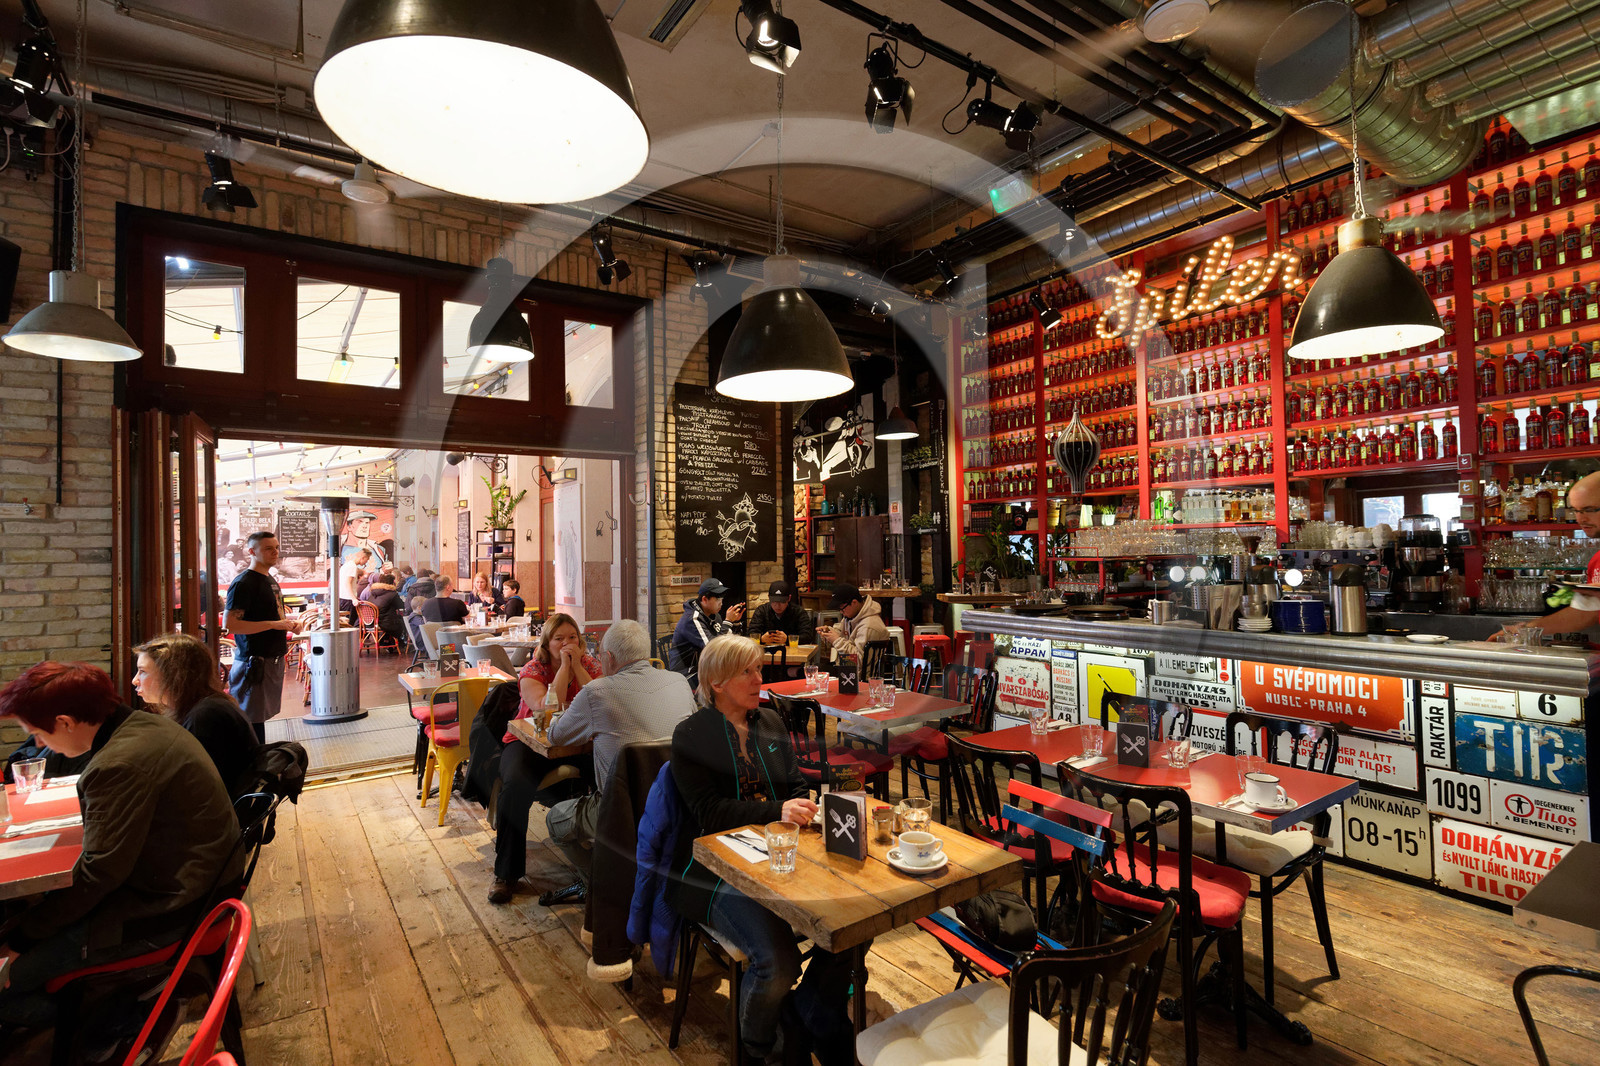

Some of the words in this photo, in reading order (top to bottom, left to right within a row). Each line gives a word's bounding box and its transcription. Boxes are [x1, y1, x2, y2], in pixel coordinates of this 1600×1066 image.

[1254, 665, 1264, 685] U
[1273, 667, 1379, 701] SVÉPOMOCI
[1358, 705, 1367, 717] 4
[1538, 693, 1558, 716] 6
[1425, 705, 1446, 760] RAKTÁR
[1357, 759, 1396, 775] TILOS!
[1359, 750, 1393, 764] ALATT
[1473, 720, 1564, 785] TIR
[1432, 777, 1482, 816] 1099
[1535, 806, 1577, 827] TILOS
[1441, 827, 1563, 870] DOHÁNYZÁ
[1452, 851, 1480, 871] NYILT
[1482, 857, 1509, 879] LÁNG
[1511, 866, 1544, 886] HASZN
[1459, 870, 1527, 902] TILO
